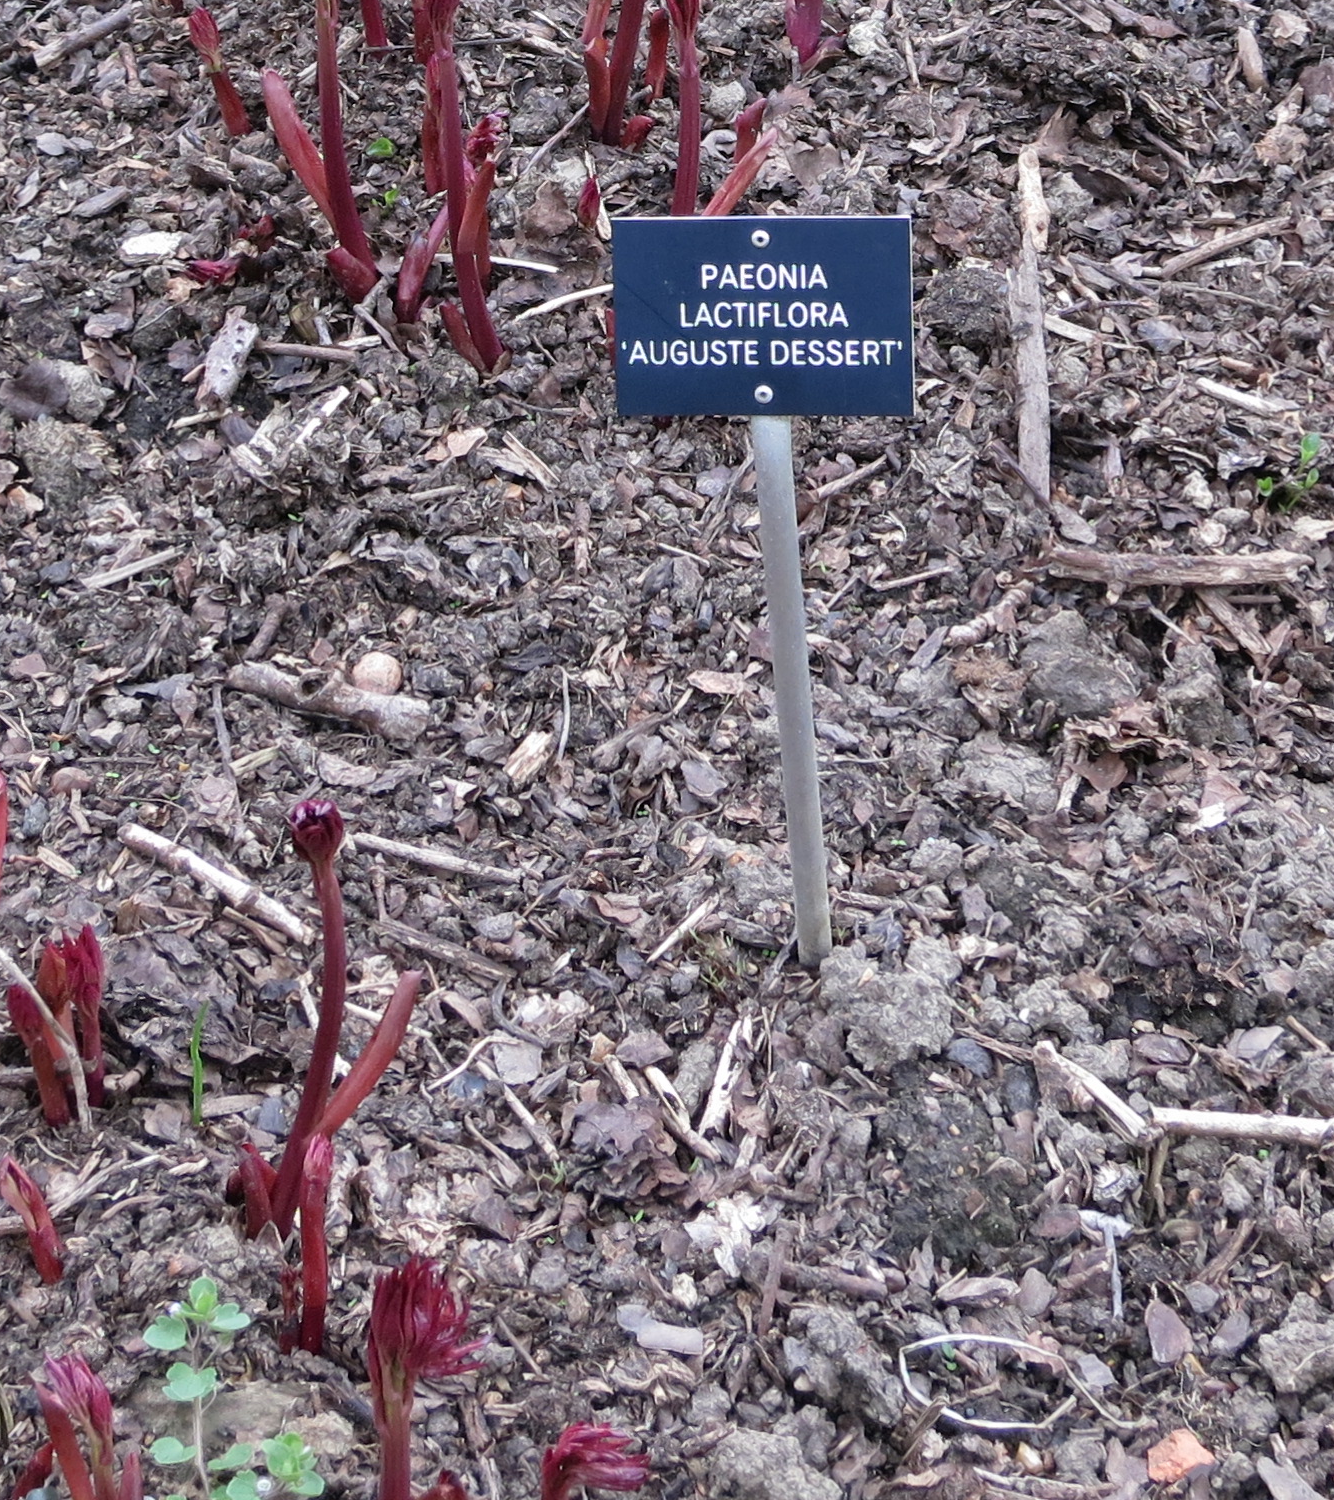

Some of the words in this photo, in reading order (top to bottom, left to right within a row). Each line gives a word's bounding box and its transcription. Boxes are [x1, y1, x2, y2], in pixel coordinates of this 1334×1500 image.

[700, 263, 828, 290] PAEONIA
[679, 302, 849, 328] LACTIFLORA
[621, 340, 760, 366] 'AUGUSTE
[770, 340, 903, 366] DESSERT'
